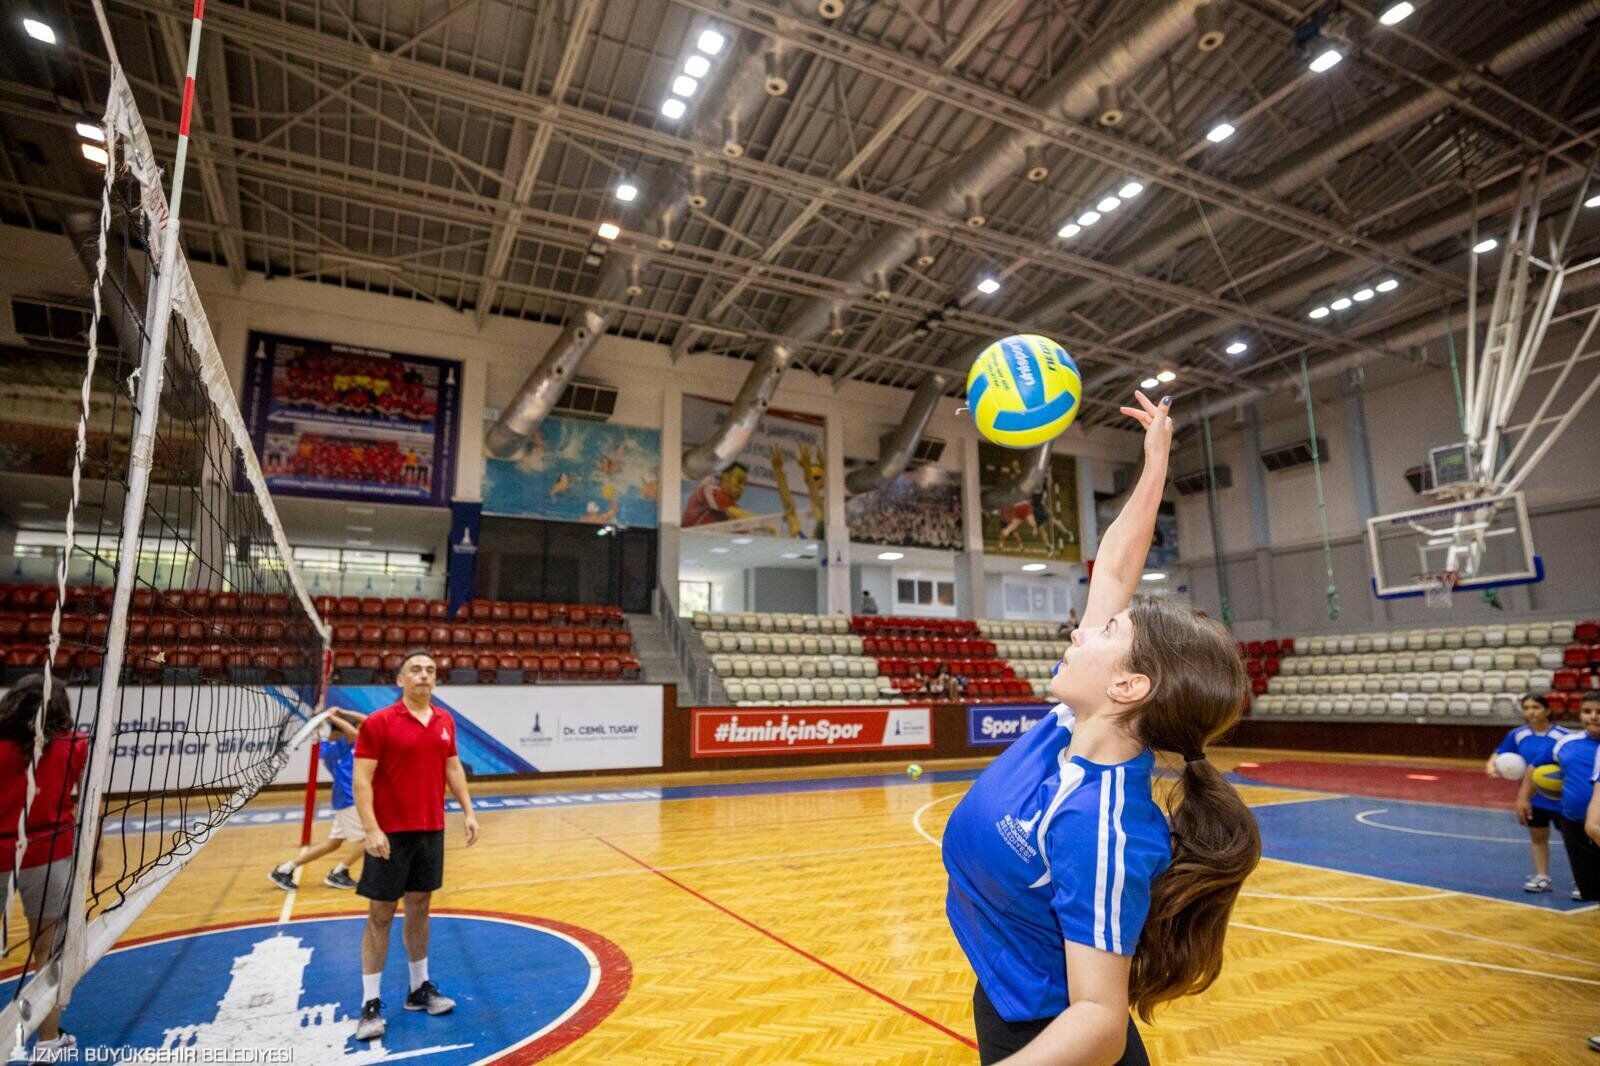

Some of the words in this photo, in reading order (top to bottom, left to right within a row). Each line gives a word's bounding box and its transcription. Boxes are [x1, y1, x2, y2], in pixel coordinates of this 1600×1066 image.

[609, 724, 639, 734] TUGAY
[714, 714, 864, 745] #İzmirİçinSpor
[981, 715, 1019, 739] Spor
[108, 738, 209, 760] aşarılar
